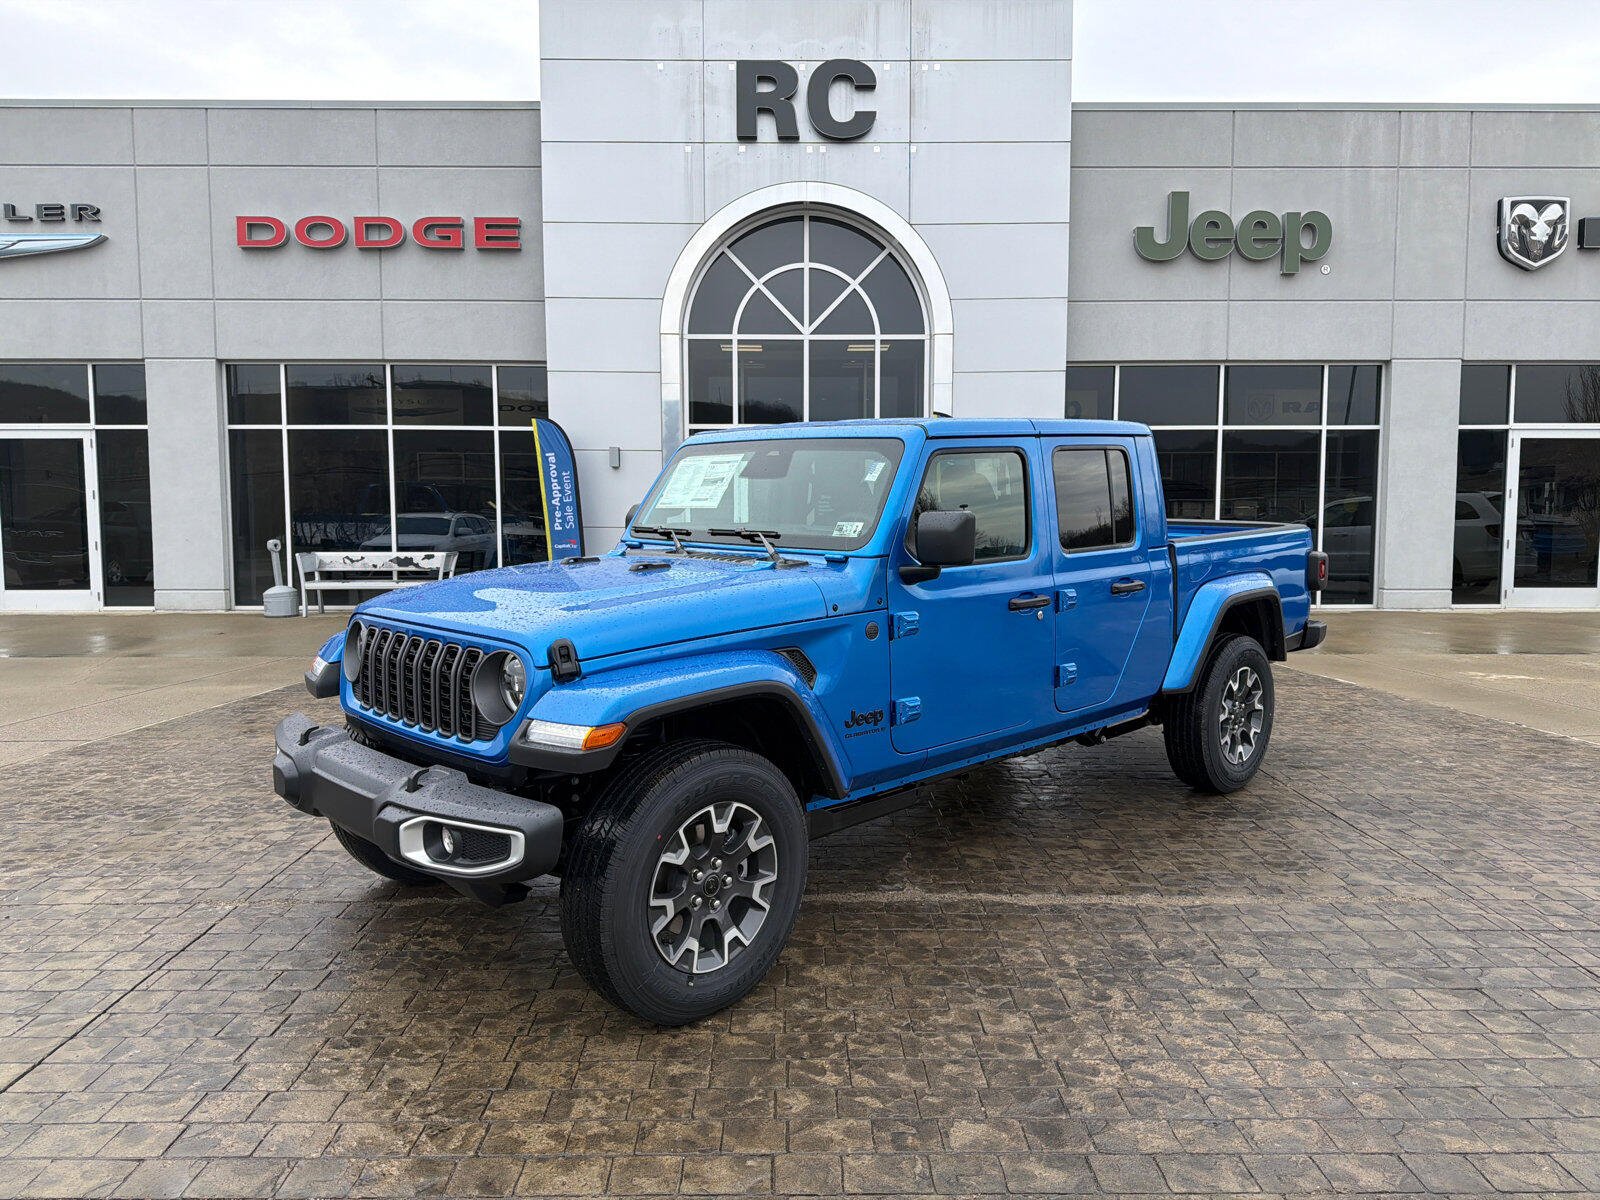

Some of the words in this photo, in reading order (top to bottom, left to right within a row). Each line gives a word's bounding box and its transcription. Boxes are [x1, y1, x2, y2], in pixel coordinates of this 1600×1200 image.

[737, 58, 877, 141] RC
[3, 203, 103, 222] LER
[236, 216, 521, 250] DODGE
[1134, 191, 1333, 276] Jeep
[545, 452, 563, 531] Pre-Approval
[562, 471, 573, 502] Event
[564, 505, 575, 529] Sale
[845, 709, 884, 728] Jeep
